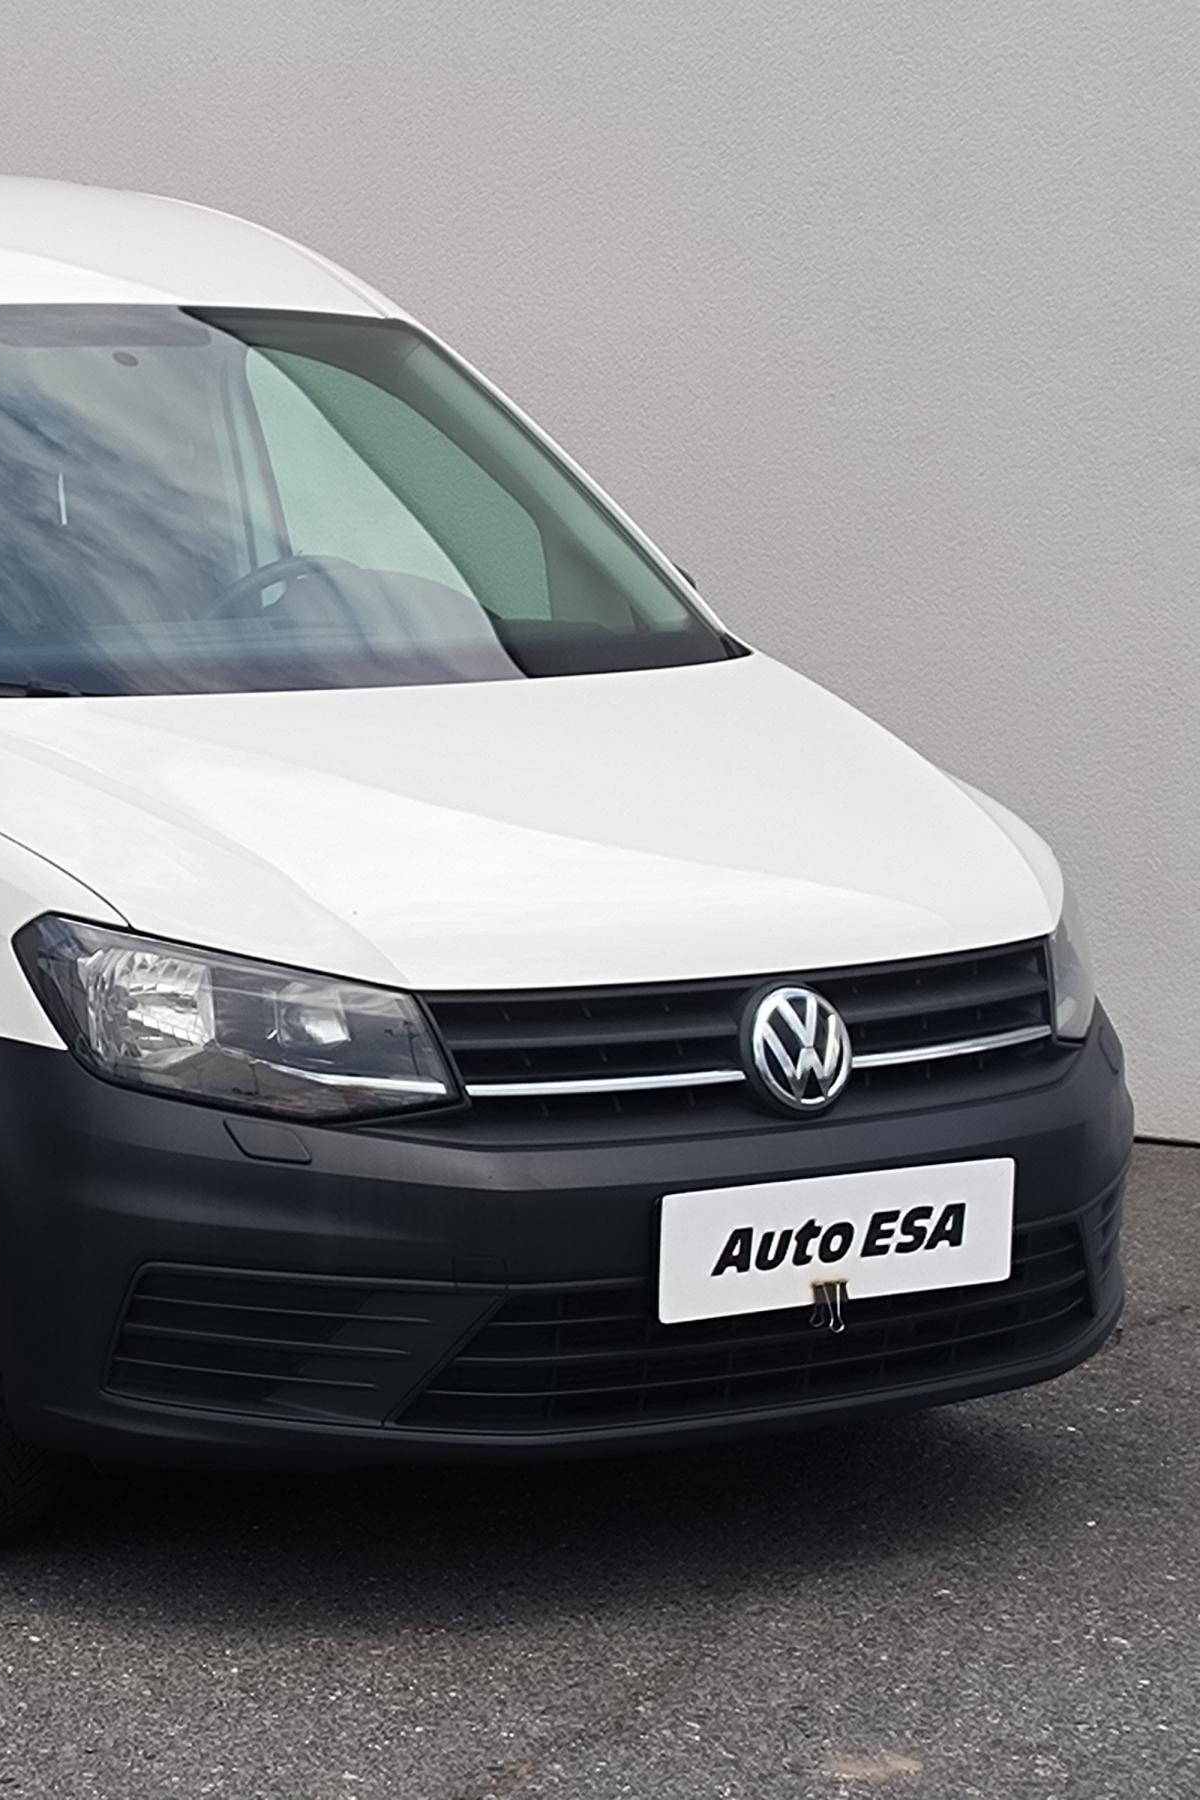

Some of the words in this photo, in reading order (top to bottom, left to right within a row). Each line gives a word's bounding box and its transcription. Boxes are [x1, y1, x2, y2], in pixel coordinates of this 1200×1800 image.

[756, 990, 848, 1106] VW
[710, 1218, 855, 1277] Auto
[860, 1202, 966, 1258] ESA
